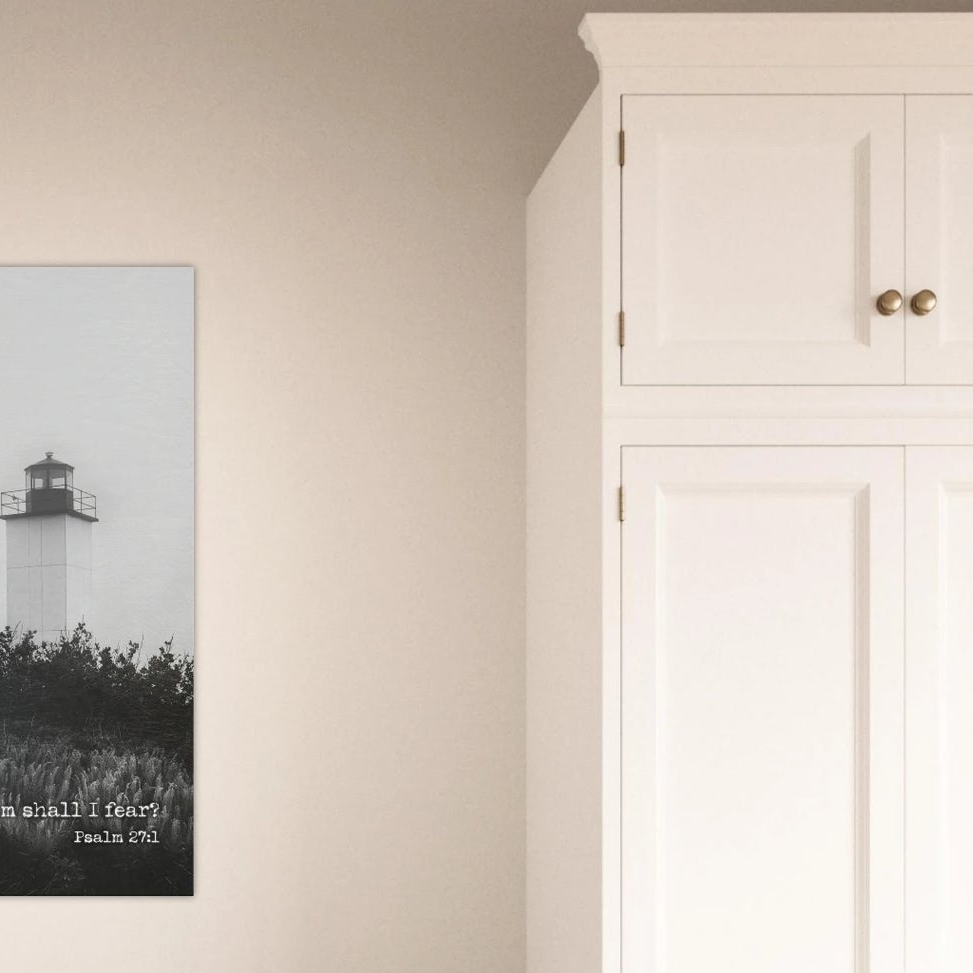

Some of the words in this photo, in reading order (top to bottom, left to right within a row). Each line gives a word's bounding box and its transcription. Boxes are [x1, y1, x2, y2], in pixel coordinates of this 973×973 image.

[22, 802, 82, 818] shall
[88, 802, 99, 818] I
[104, 802, 160, 818] fear?
[73, 831, 123, 843] Psalm
[128, 831, 160, 843] 27:1
